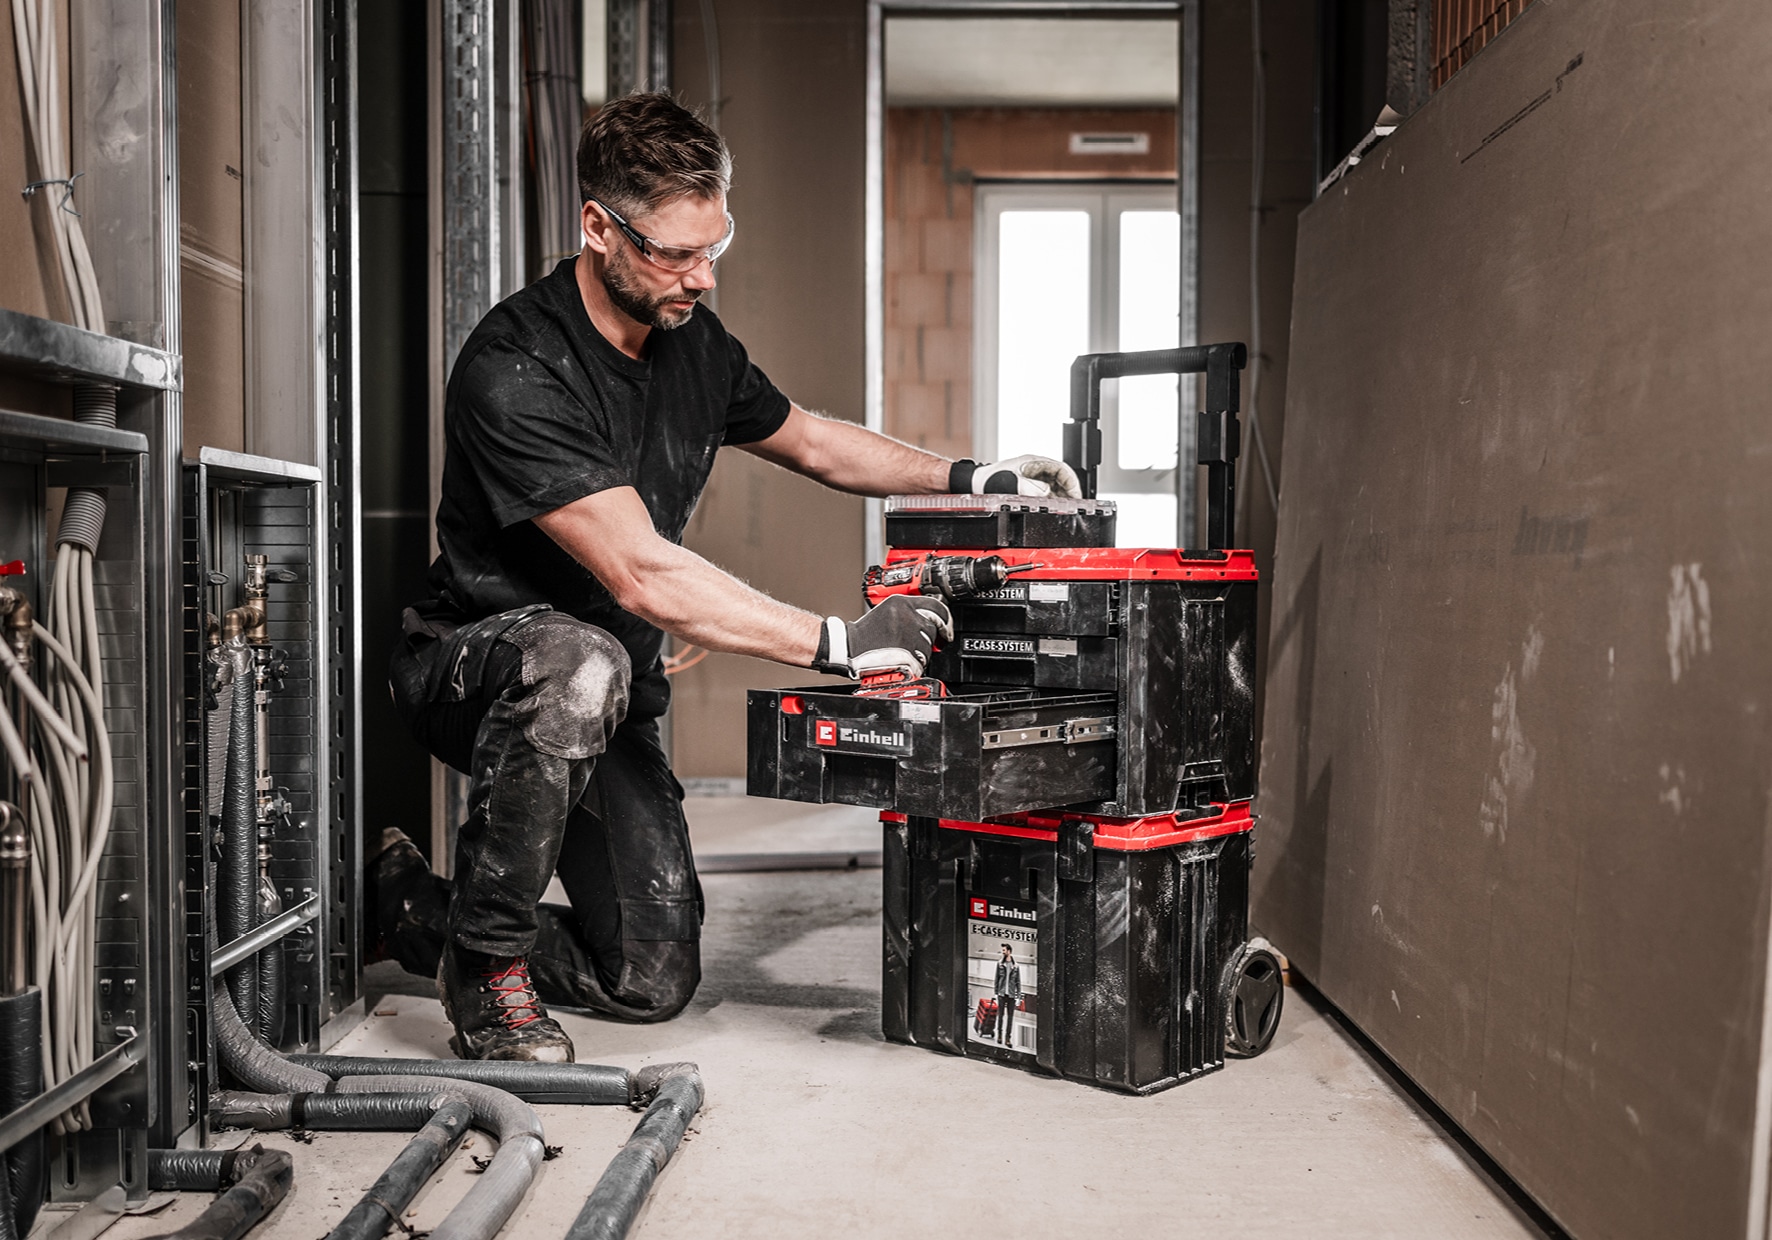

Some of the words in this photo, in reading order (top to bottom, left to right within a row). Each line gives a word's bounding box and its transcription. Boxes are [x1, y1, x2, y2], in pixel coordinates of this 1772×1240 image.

[964, 640, 1034, 653] E-CASE-SYSTEM
[840, 728, 904, 747] Einhell
[989, 904, 1037, 921] Einhel
